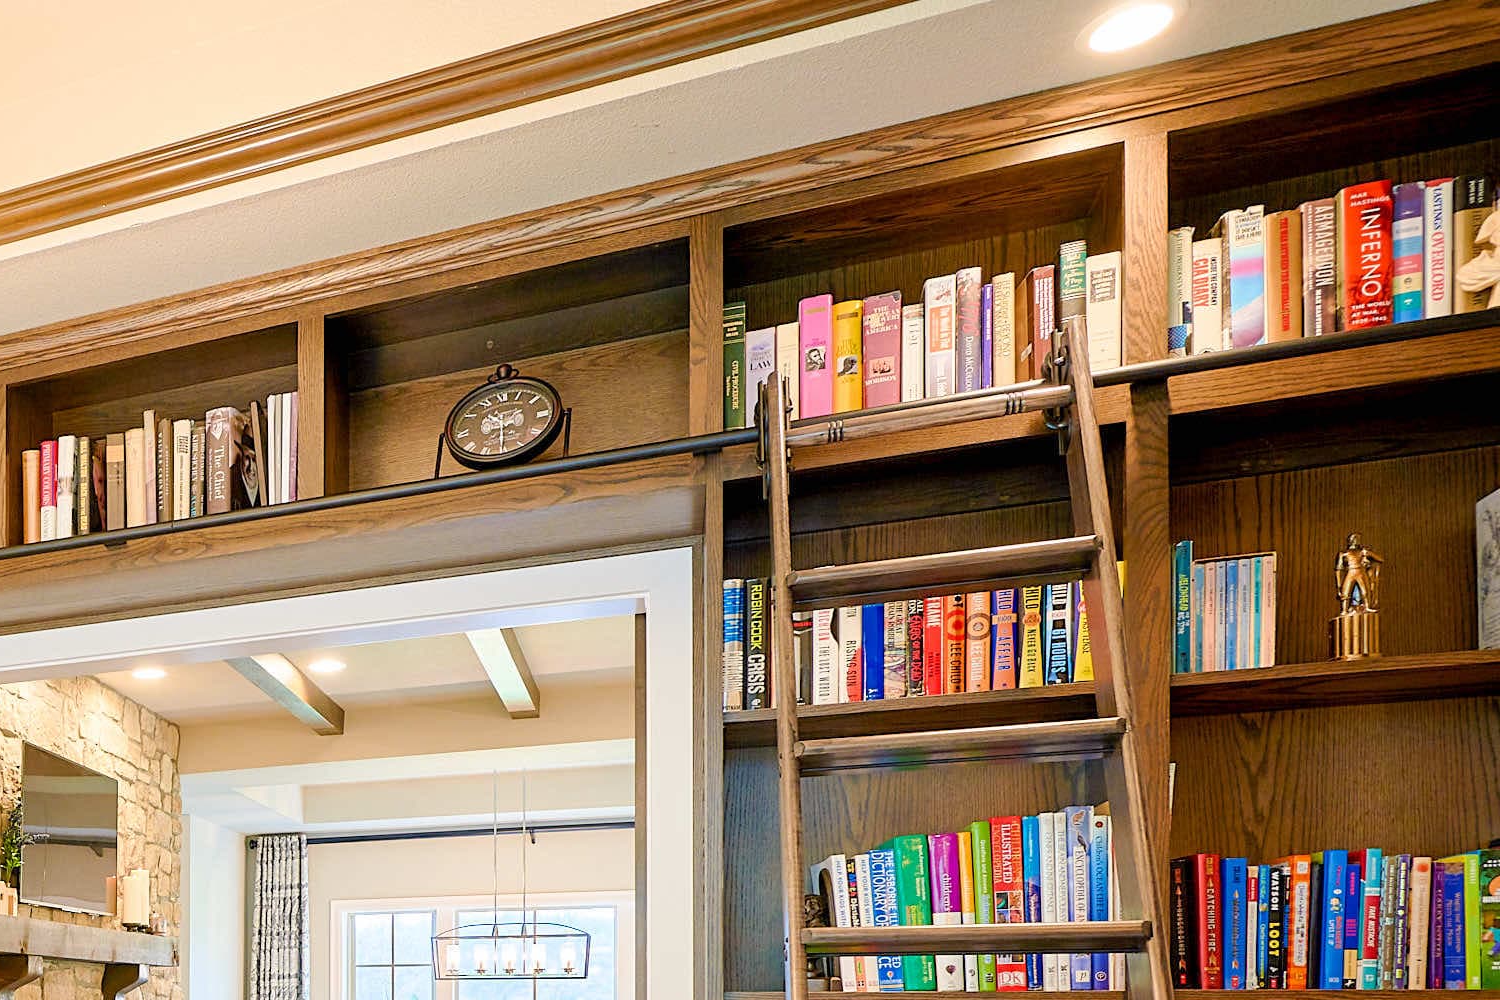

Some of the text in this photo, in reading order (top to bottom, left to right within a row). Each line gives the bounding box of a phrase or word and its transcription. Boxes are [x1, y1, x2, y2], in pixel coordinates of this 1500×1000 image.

[1315, 205, 1335, 287] ARMAGEDDON
[1361, 207, 1381, 297] INFERNO
[1432, 231, 1445, 302] OVERLORD
[1193, 257, 1209, 308] CIA DIARY
[958, 302, 981, 337] 1776
[750, 360, 772, 371] LAW
[214, 445, 225, 500] The Chief
[910, 615, 922, 640] EATERS
[927, 597, 941, 628] FRAME
[1026, 588, 1040, 610] HILD
[1051, 583, 1067, 673] HILD 61 HOURS
[748, 584, 766, 694] ROBIN COOK CRISIS
[998, 590, 1011, 671] HILD AFFAIR
[818, 676, 830, 697] WORLD
[846, 640, 857, 688] RISING SUN
[910, 661, 922, 681] DEAD
[950, 642, 962, 684] LEE CHILD
[872, 852, 886, 912] DICTIONARY
[885, 851, 897, 911] THE USBORNE
[1001, 823, 1013, 883] ILLUSTRATED
[1011, 823, 1021, 883] CHILDREN'S
[1075, 851, 1086, 914] ENCYCLOPEDIA OF
[1207, 888, 1216, 952] CATCHING FIRE
[1269, 871, 1280, 957] WATSON LOOT
[1001, 972, 1023, 986] DK
